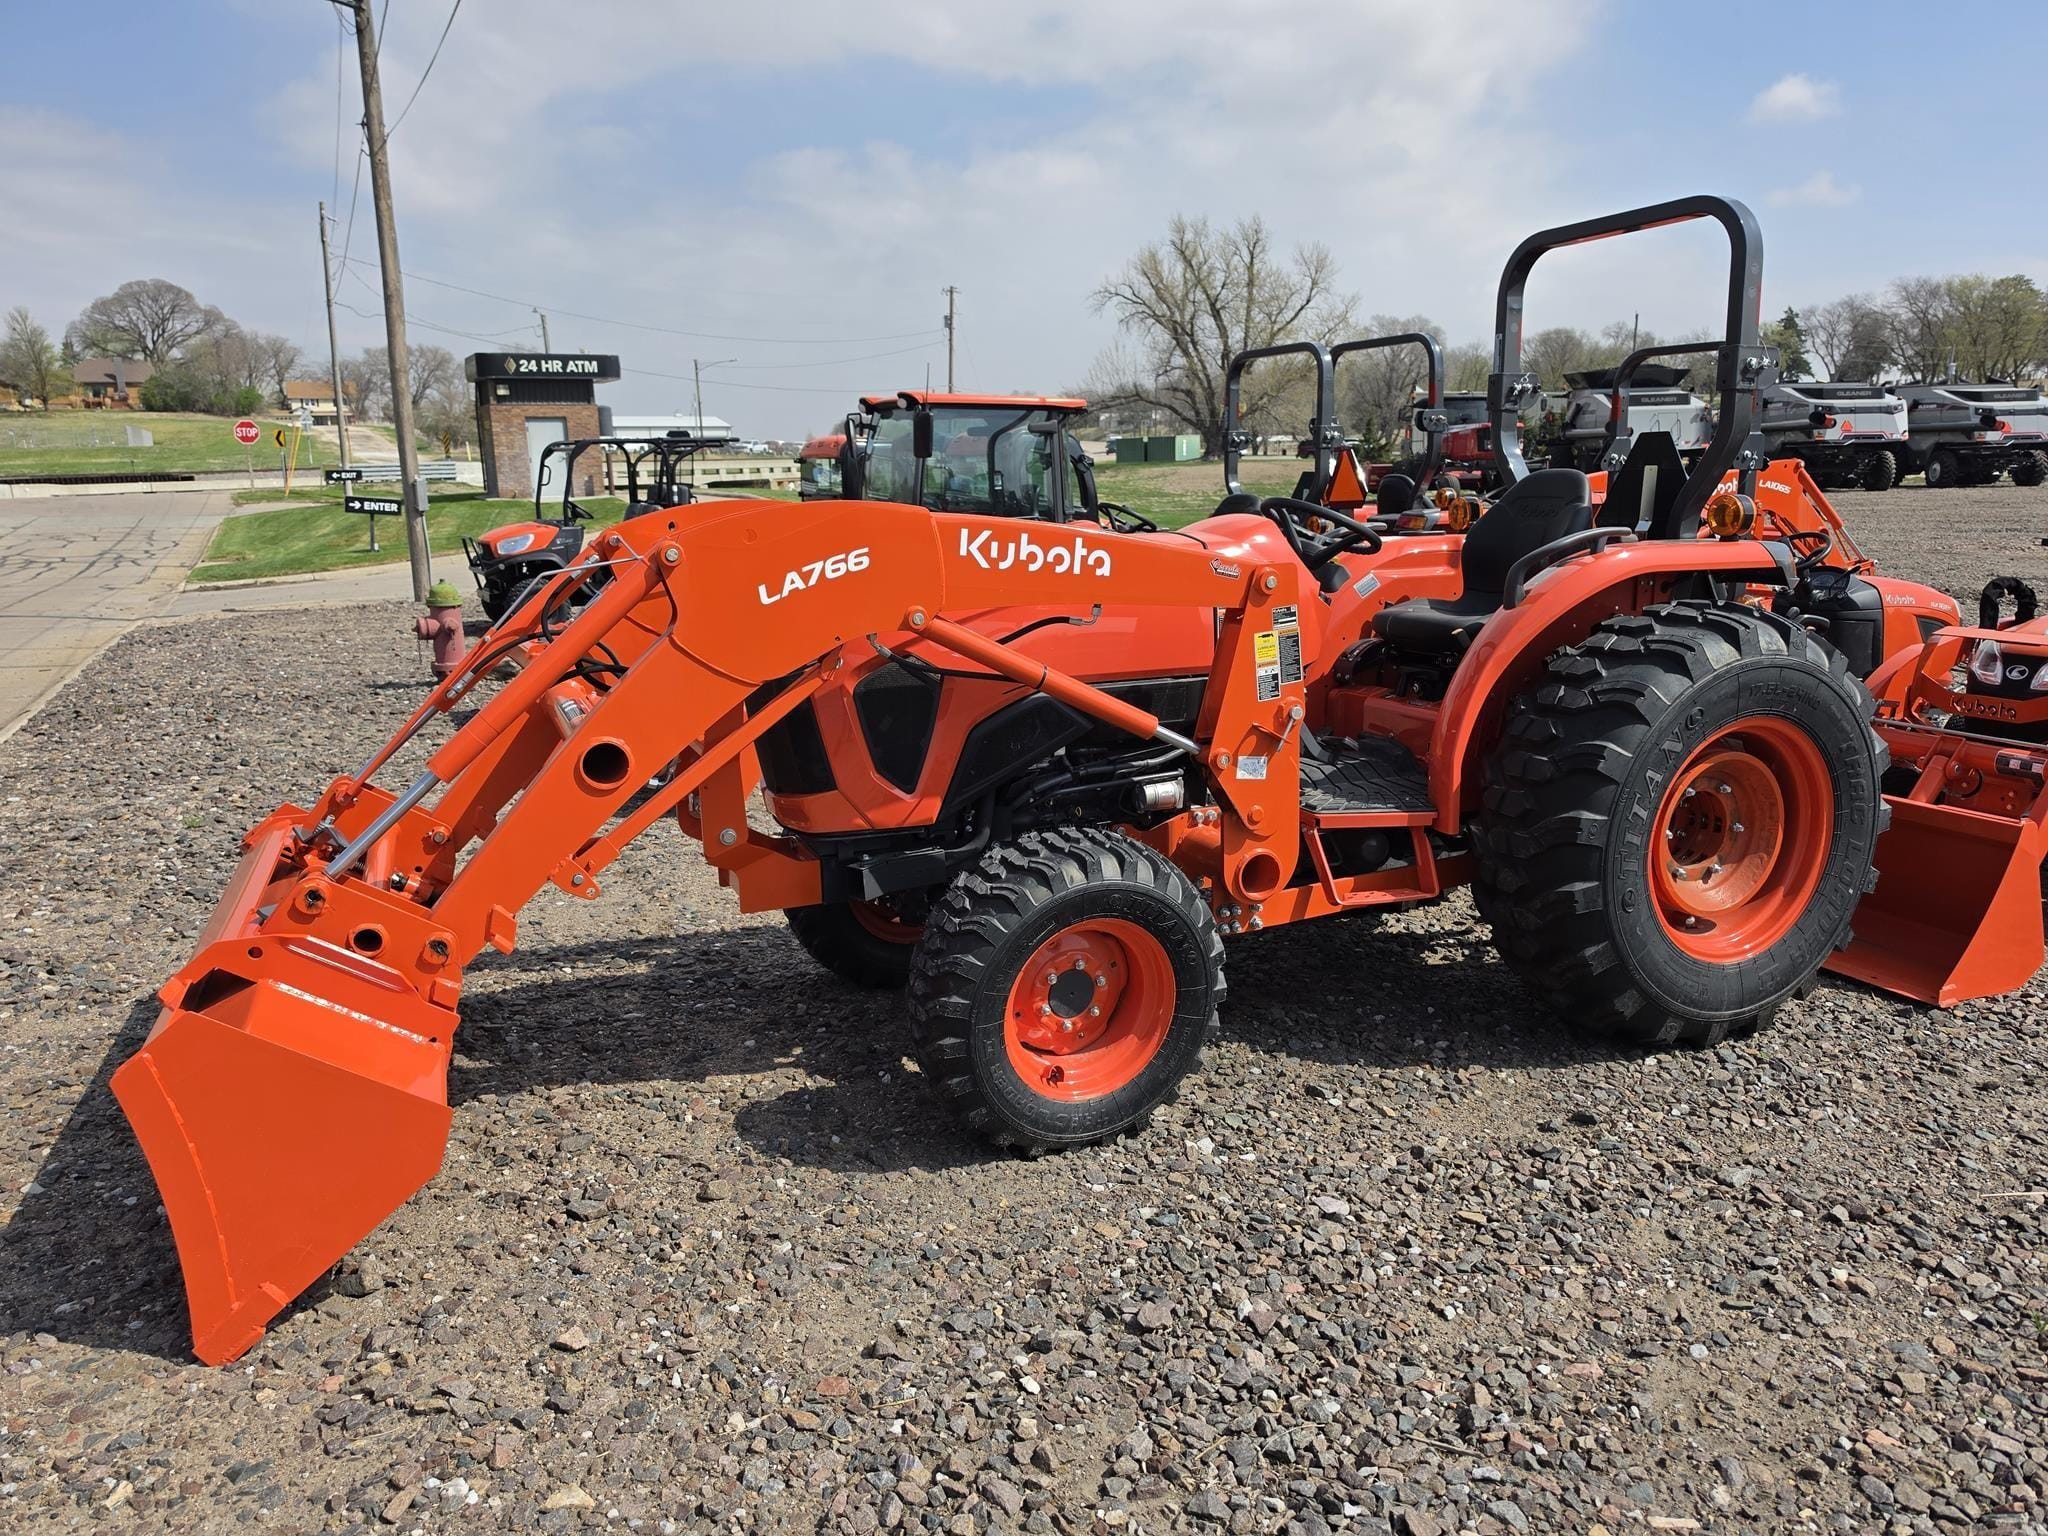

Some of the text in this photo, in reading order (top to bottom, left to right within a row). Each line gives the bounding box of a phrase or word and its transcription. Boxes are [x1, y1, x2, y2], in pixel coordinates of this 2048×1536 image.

[519, 359, 598, 373] 24 HR ATM
[236, 427, 258, 438] STOP
[1759, 479, 1791, 494] LA1065
[363, 501, 399, 512] ENTER
[959, 528, 1112, 577] Kubota
[758, 547, 870, 605] LA766
[1885, 594, 1916, 604] Kubota
[1950, 695, 2018, 720] Kubota
[1618, 726, 1685, 881] TITAN
